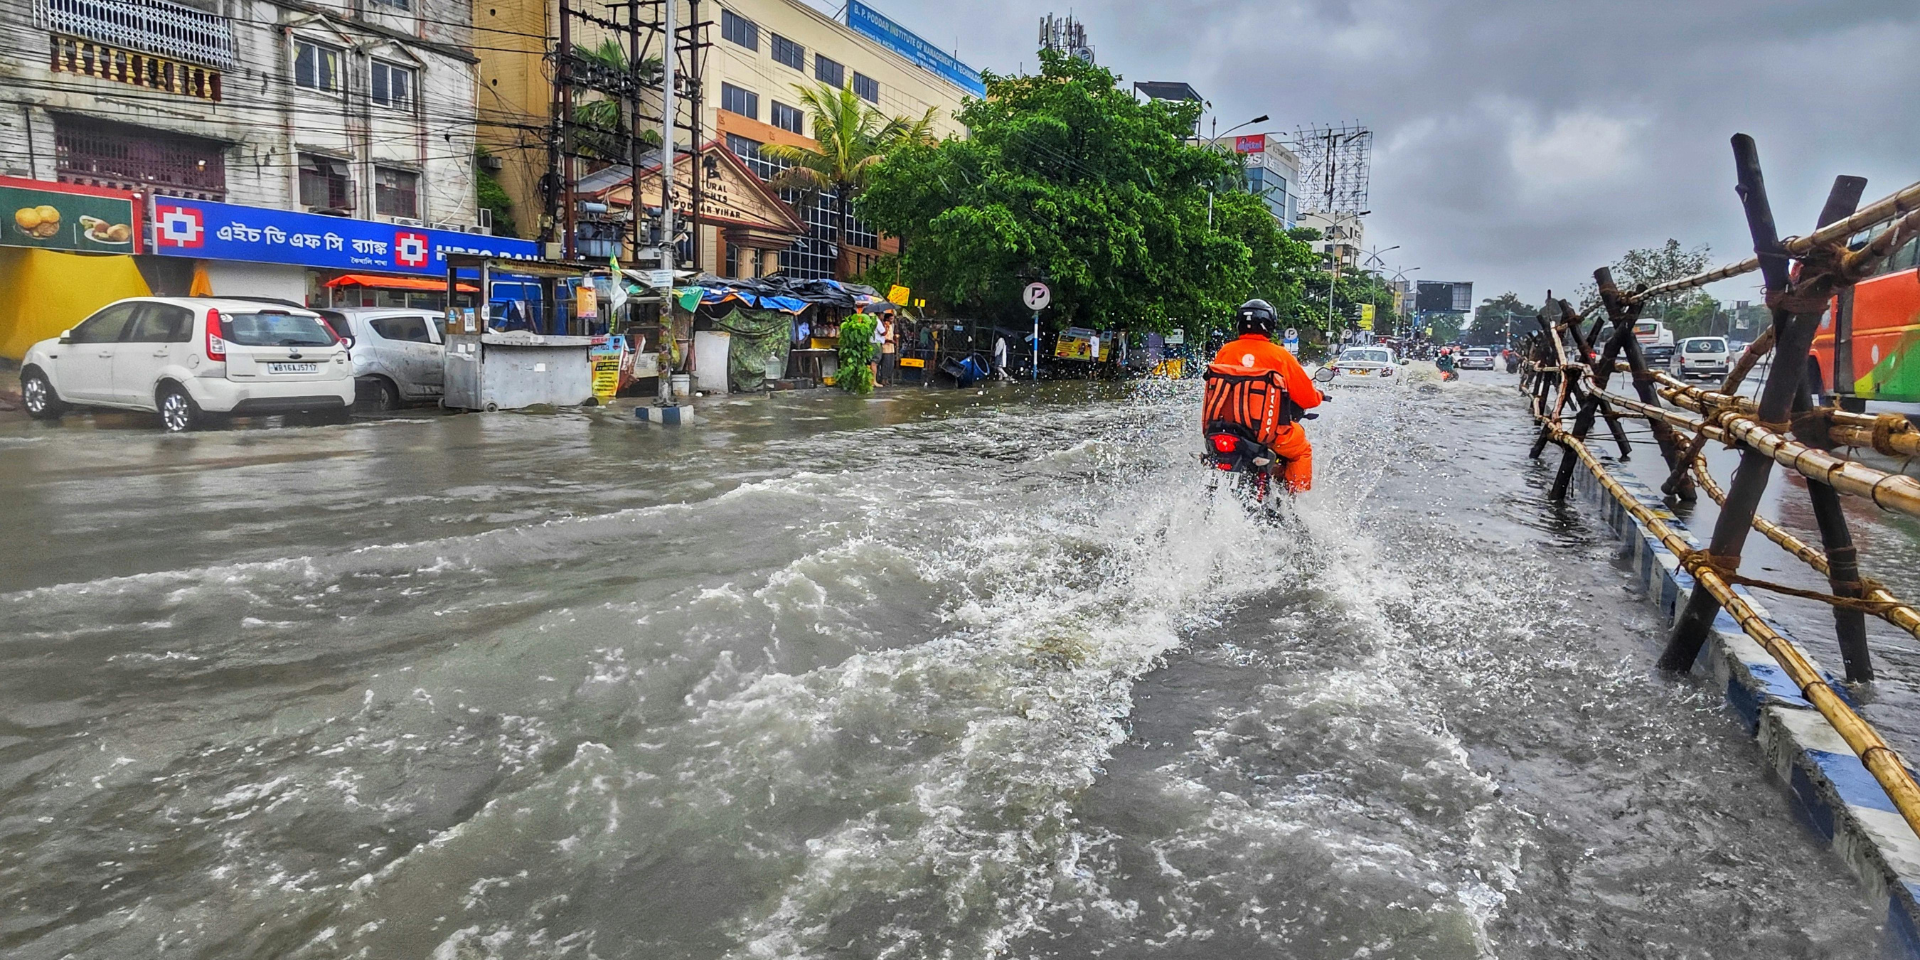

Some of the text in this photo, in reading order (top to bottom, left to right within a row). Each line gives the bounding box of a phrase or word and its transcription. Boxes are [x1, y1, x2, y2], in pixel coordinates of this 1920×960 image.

[854, 4, 860, 16] B.
[861, 8, 867, 19] P.
[867, 11, 890, 32] PODDAR
[890, 23, 916, 47] INSTITUTE
[916, 40, 923, 52] OF
[923, 43, 953, 67] MANAGEMENT
[674, 200, 741, 218] PODAR VIHAR
[264, 226, 287, 245] ডি
[290, 232, 321, 249] এফ
[324, 232, 344, 251] সি
[274, 362, 317, 372] WB16AJ5717
